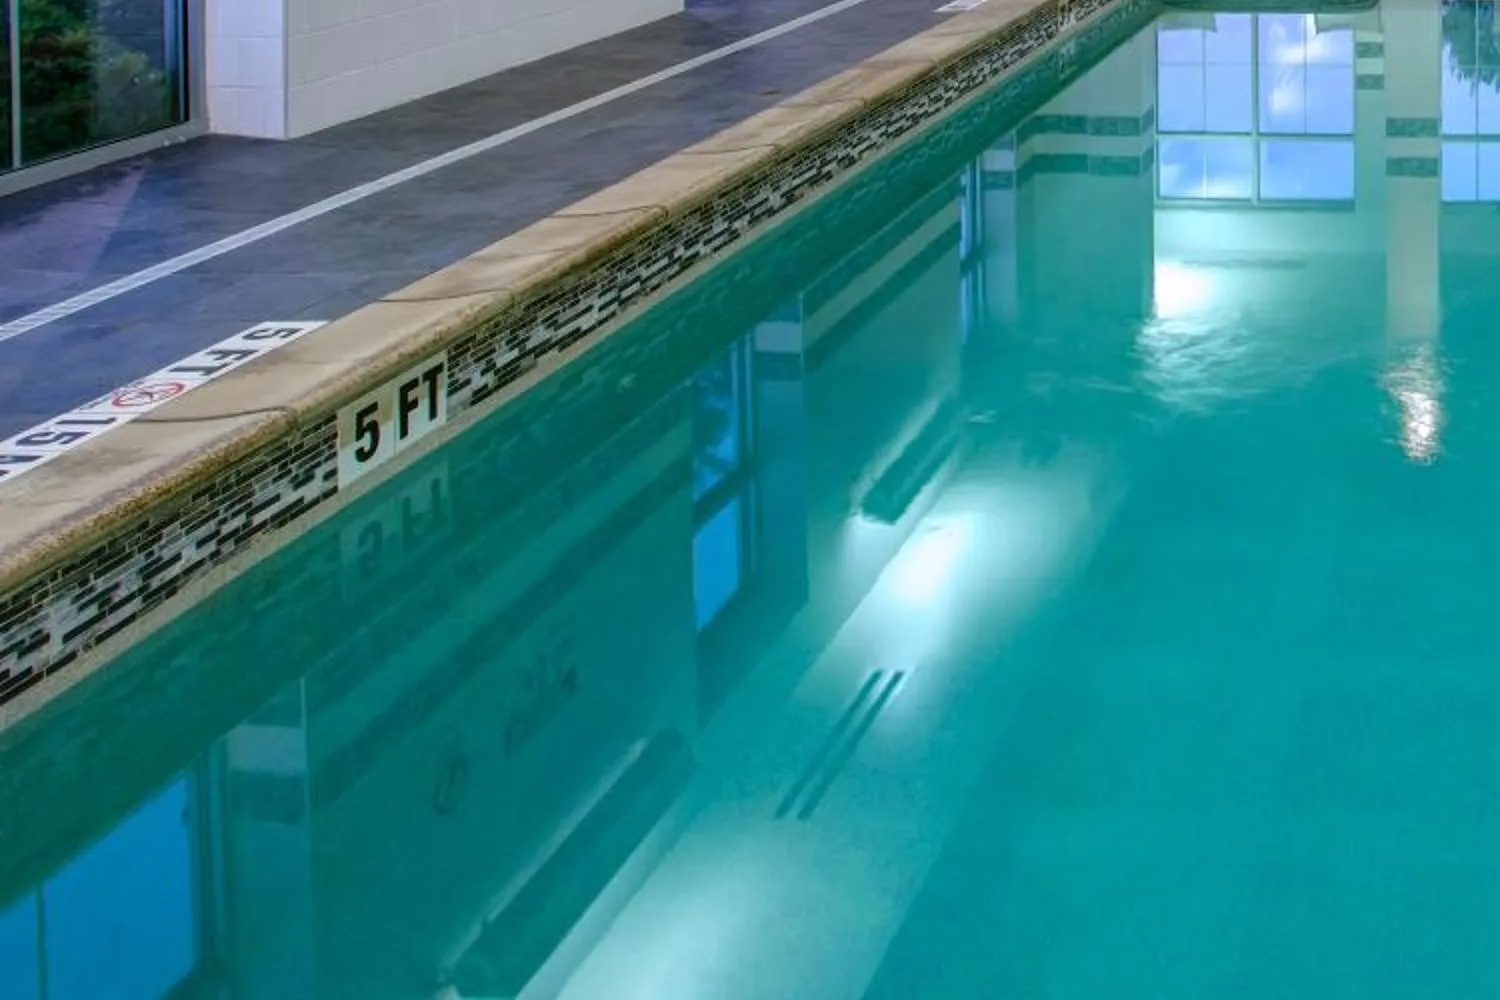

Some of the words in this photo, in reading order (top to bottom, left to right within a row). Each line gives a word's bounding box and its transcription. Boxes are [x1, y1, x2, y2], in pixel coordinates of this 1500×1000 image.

[241, 327, 304, 341] 5
[168, 349, 260, 376] FT
[354, 400, 380, 463] 5
[399, 361, 445, 441] FT
